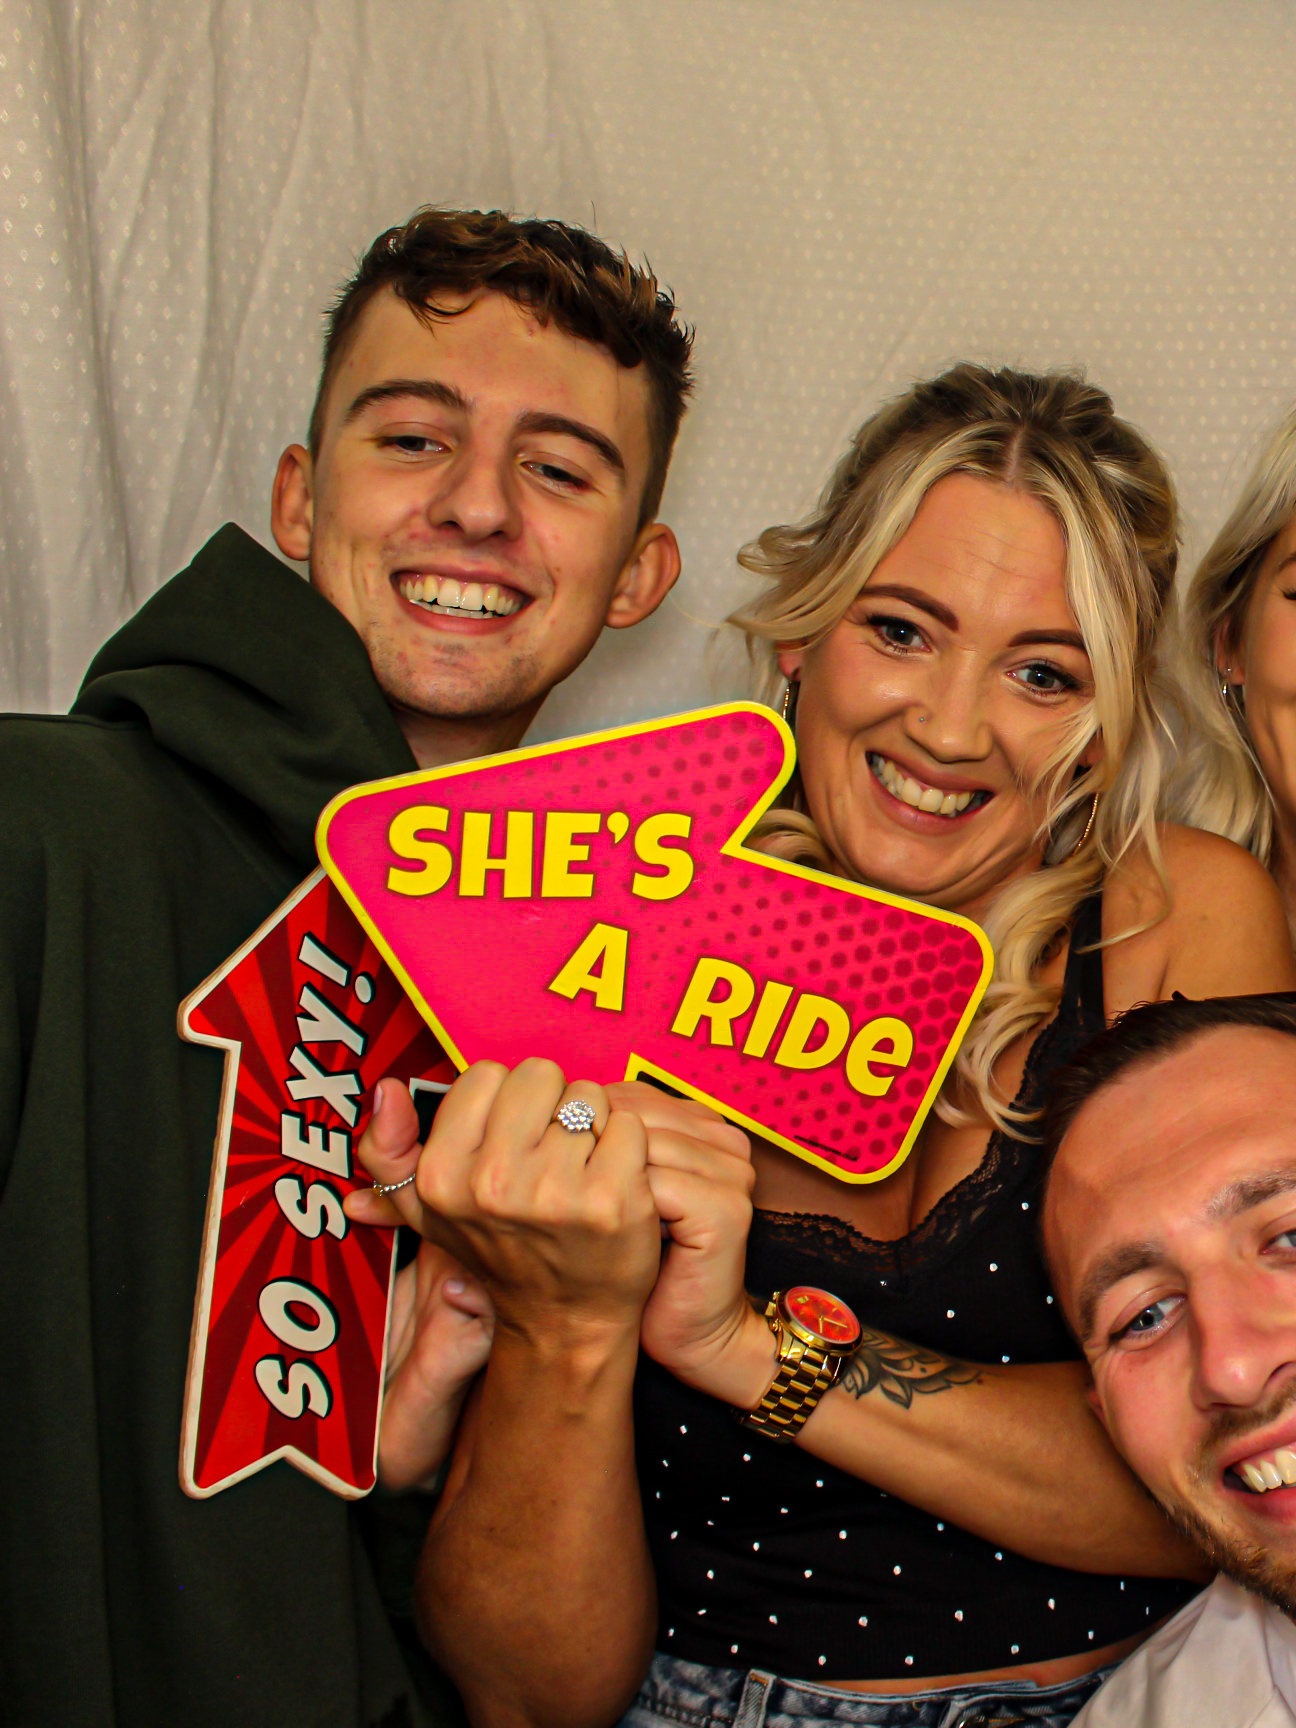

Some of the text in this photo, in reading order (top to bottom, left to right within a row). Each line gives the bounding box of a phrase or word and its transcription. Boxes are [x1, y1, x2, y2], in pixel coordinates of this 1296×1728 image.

[386, 804, 696, 902] SHE'S
[548, 922, 630, 1012] A
[254, 931, 378, 1421] SO SEXY!
